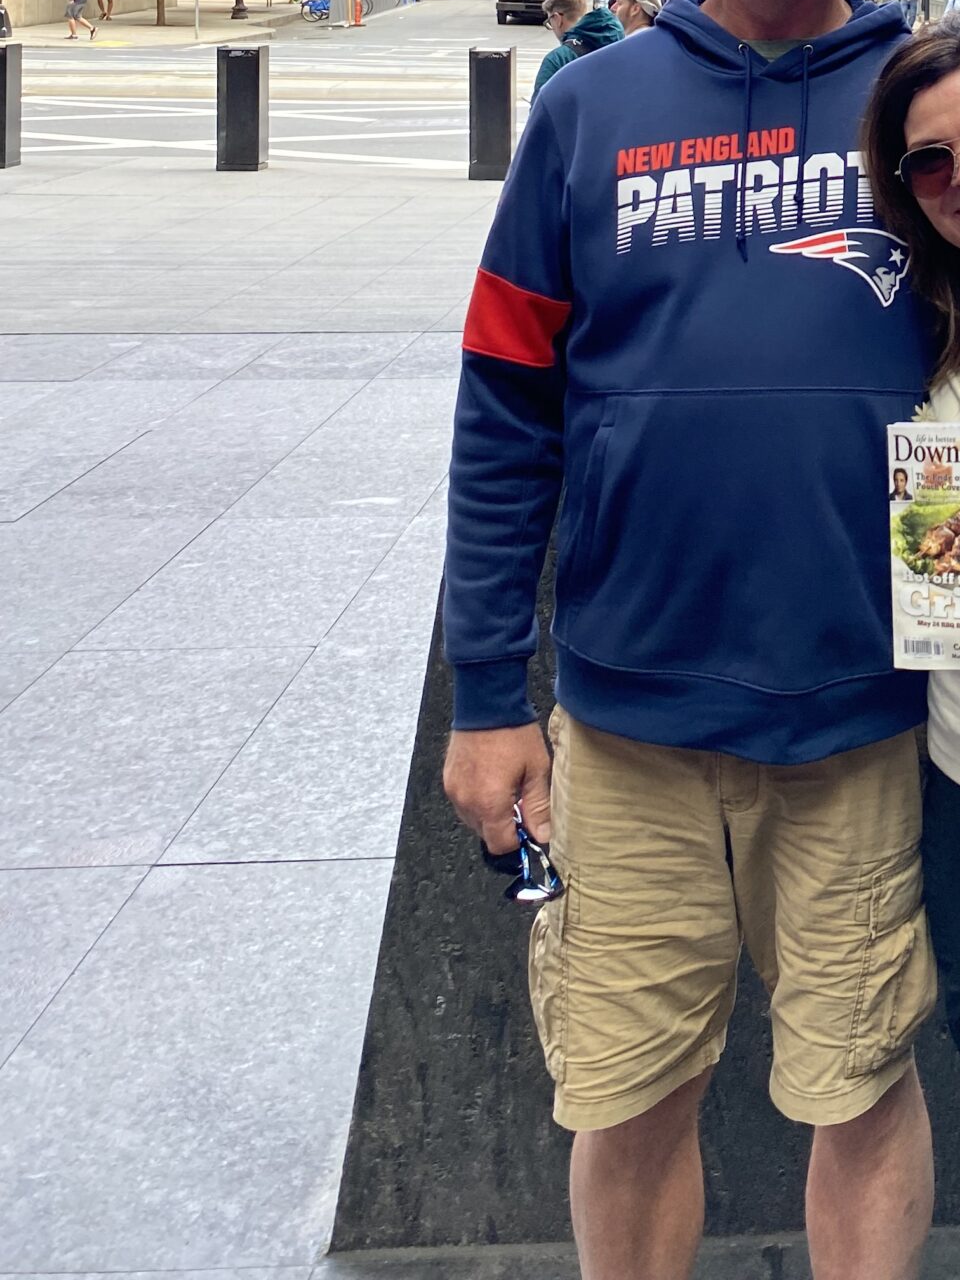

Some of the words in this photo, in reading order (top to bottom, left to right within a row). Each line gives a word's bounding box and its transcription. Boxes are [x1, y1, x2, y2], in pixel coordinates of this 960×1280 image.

[617, 141, 675, 176] NEW
[680, 127, 795, 165] ENGLAND
[616, 151, 875, 255] PATRIOT
[915, 434, 927, 443] life
[915, 473, 931, 481] The
[941, 482, 960, 491] Cove
[903, 570, 930, 583] Hot
[932, 572, 955, 585] off
[917, 620, 931, 628] May
